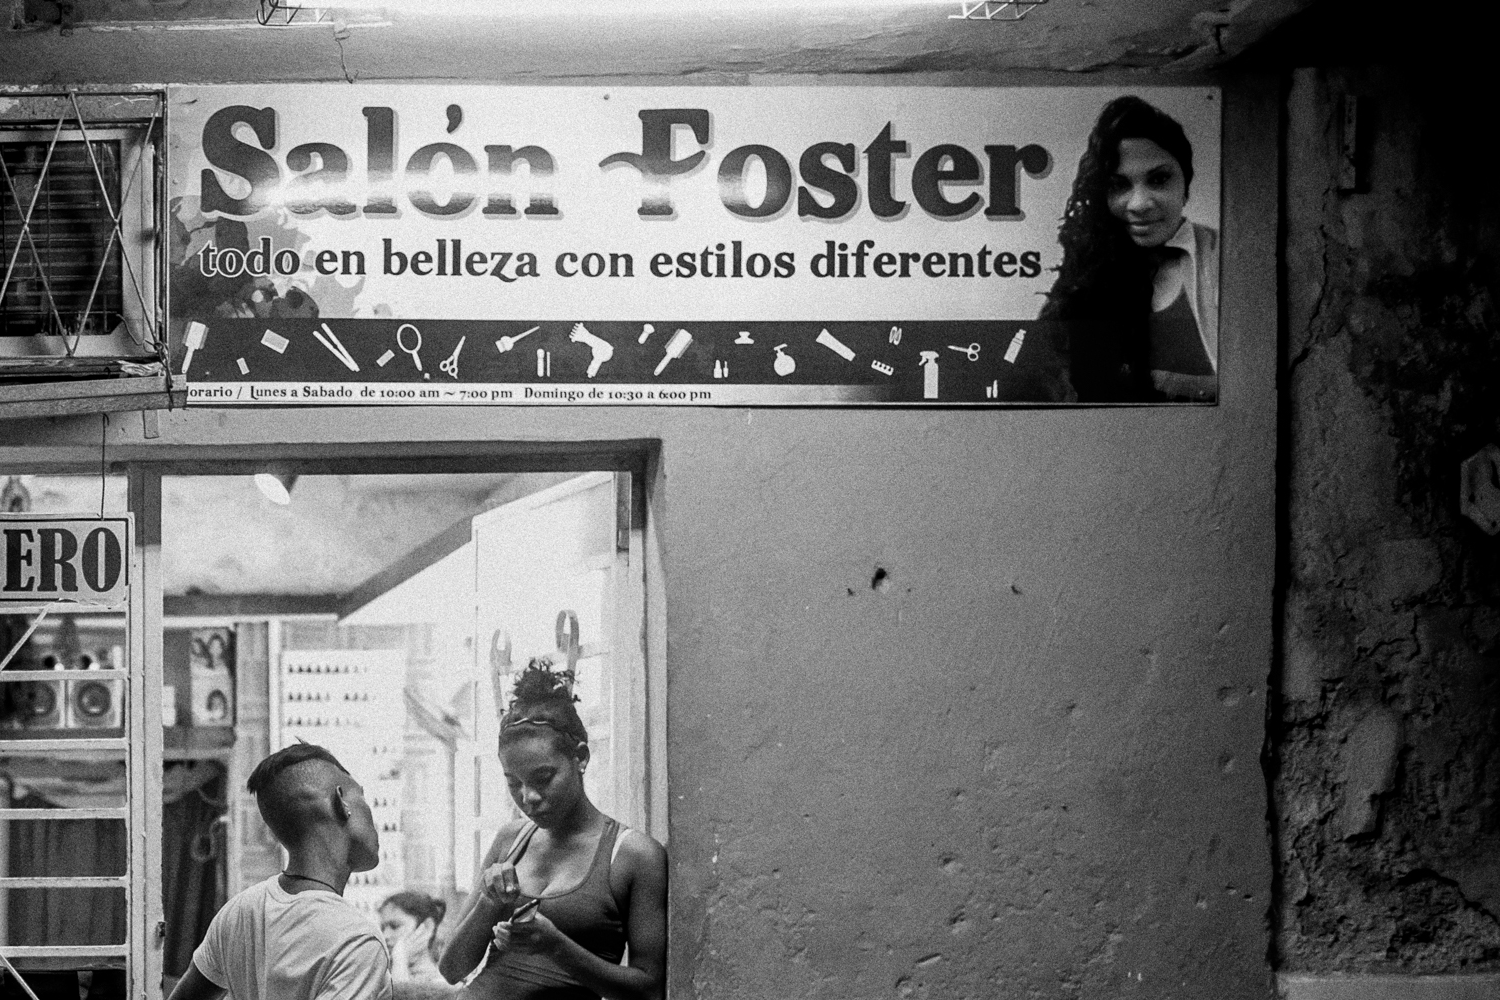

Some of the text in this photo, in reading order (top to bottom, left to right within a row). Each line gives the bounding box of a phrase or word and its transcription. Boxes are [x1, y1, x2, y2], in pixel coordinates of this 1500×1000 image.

[199, 104, 1053, 223] Salón Foster
[199, 237, 1041, 282] todo en belleza con estilos diferentes
[186, 385, 232, 397] orario
[250, 386, 286, 400] Lunes
[291, 389, 298, 398] a
[303, 386, 352, 398] Sabado
[360, 386, 375, 398] de
[380, 389, 415, 398] 10:00
[420, 390, 439, 398] am
[460, 390, 487, 400] 7:00
[491, 390, 513, 402] pm
[524, 387, 583, 401] Domingo
[588, 387, 604, 399] de
[609, 390, 642, 400] 10:30
[647, 391, 655, 399] a
[658, 388, 686, 399] 6:00
[690, 391, 711, 403] pm
